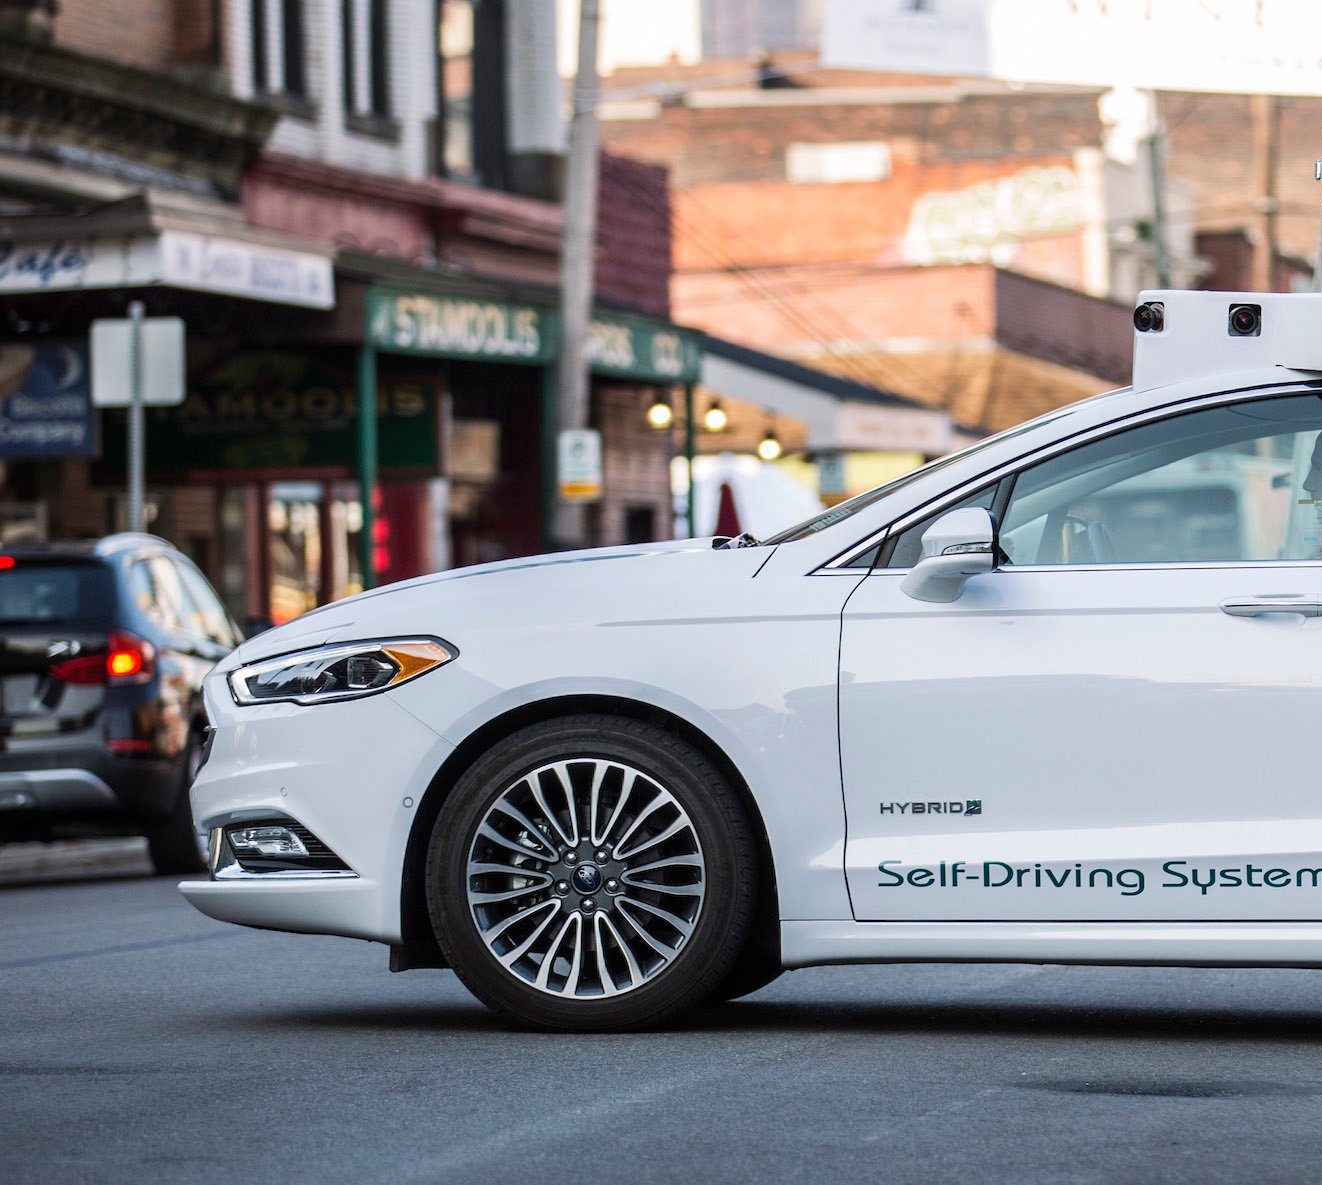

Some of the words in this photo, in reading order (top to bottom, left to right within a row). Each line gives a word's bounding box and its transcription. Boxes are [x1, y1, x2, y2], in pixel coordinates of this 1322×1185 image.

[396, 297, 539, 357] STAMOOLIS
[110, 385, 426, 421] AMOOLIS
[880, 802, 963, 815] HYBRID
[877, 860, 1145, 897] Self-Driving
